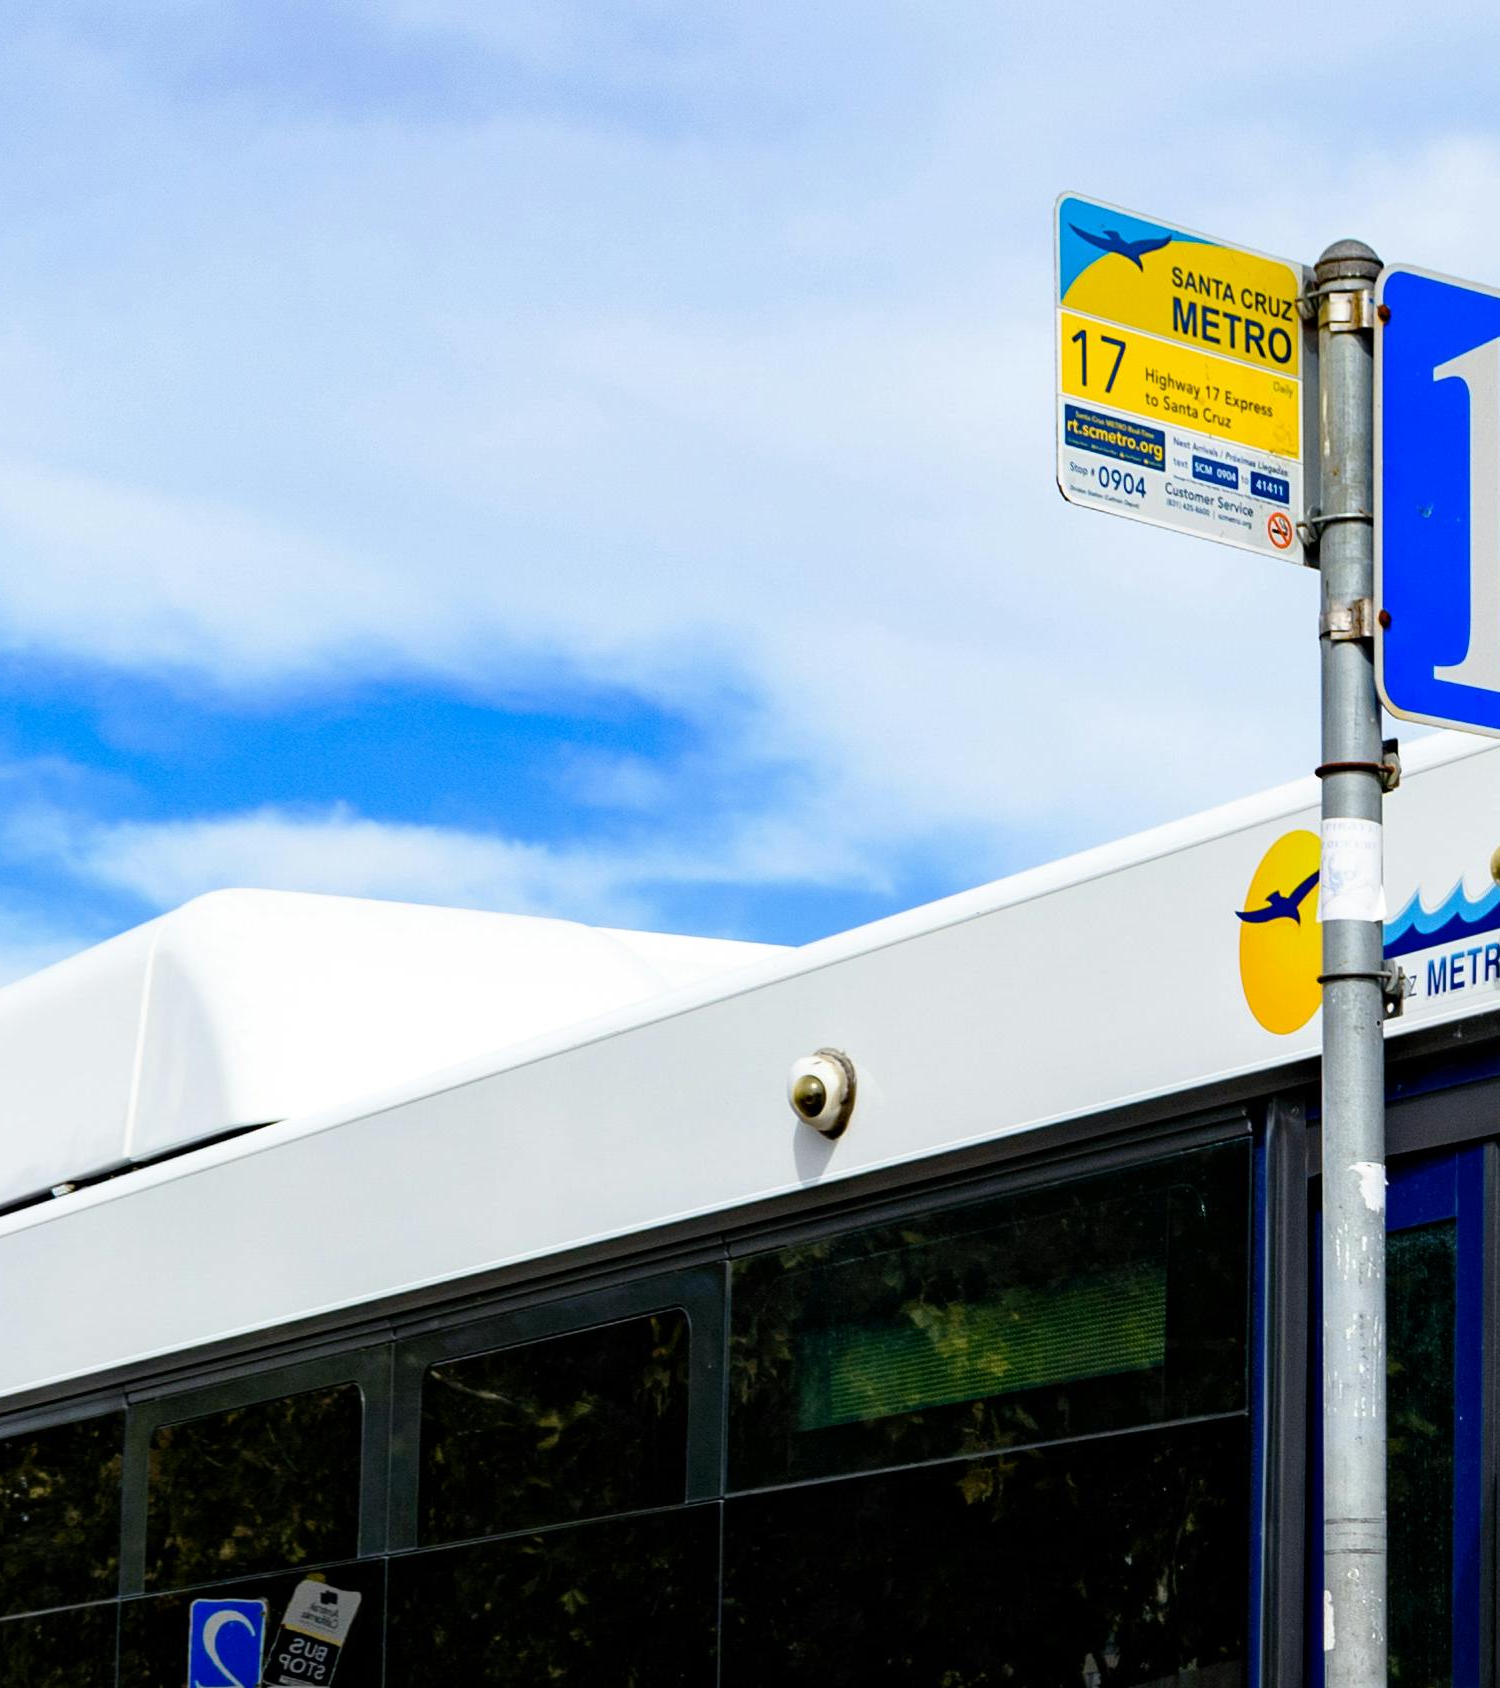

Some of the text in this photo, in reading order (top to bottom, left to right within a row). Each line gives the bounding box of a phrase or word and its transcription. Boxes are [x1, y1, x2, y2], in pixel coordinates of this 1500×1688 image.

[1172, 266, 1293, 322] SANTA CRUZ
[1173, 296, 1292, 364] METRO
[1072, 329, 1126, 394] 17
[1145, 367, 1274, 418] Highway 17 Express
[1272, 380, 1294, 399] Daily
[1145, 392, 1232, 429] to Santa Cruz
[1066, 418, 1163, 462] rt.scmetro.org
[1069, 461, 1089, 476] Stop
[1099, 466, 1147, 498] 0904
[1173, 457, 1284, 496] text SCM 0904 to 41411
[1165, 481, 1215, 507] Customer
[1217, 496, 1254, 518] Service
